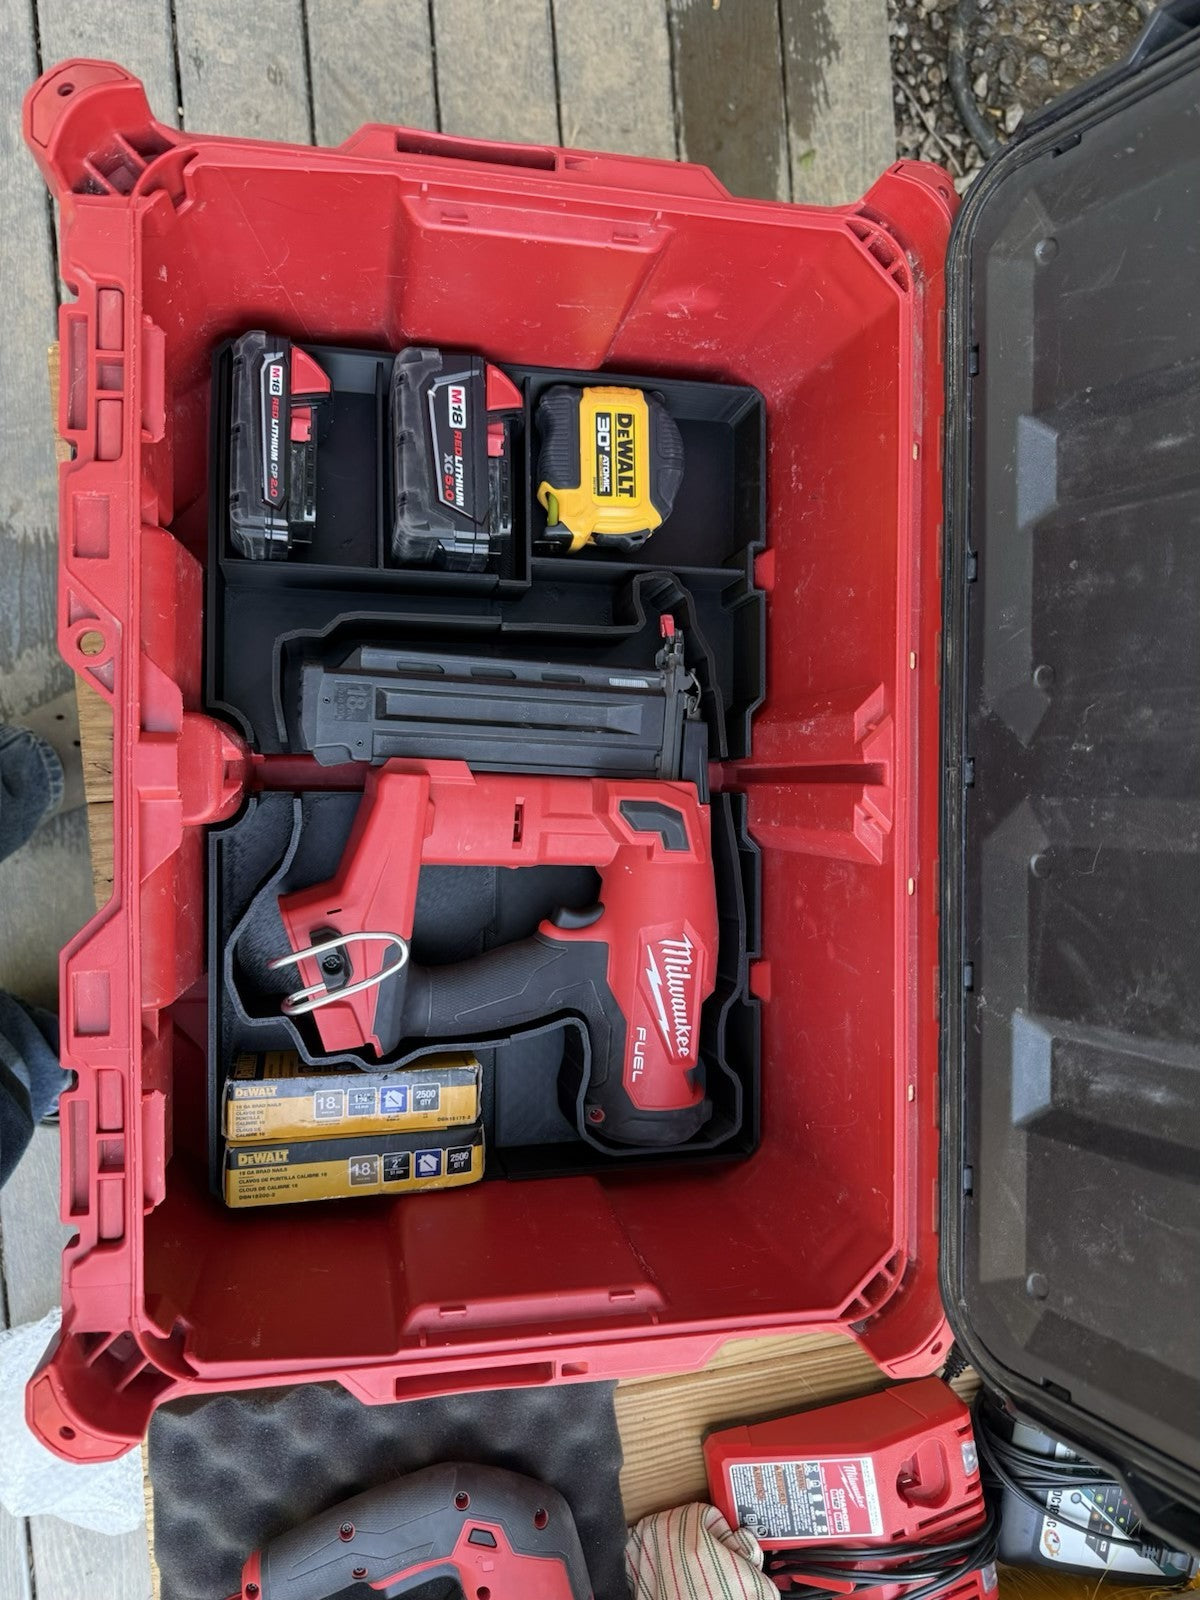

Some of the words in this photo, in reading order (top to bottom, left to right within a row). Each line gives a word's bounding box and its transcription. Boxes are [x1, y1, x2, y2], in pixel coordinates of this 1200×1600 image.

[272, 367, 280, 393] M18
[451, 389, 463, 425] M18
[270, 397, 280, 461] REDLITHIUM
[454, 430, 465, 507] REDLITHIUM
[658, 933, 694, 1058] Milwaukee
[632, 1026, 647, 1083] FUEL
[318, 1096, 336, 1110] 18
[416, 1090, 436, 1098] 2500
[352, 1162, 370, 1176] 18
[450, 1151, 469, 1162] 2500
[842, 1463, 866, 1509] Milwaukee
[838, 1488, 851, 1533] CHARGER
[1047, 1490, 1062, 1527] DC18C
